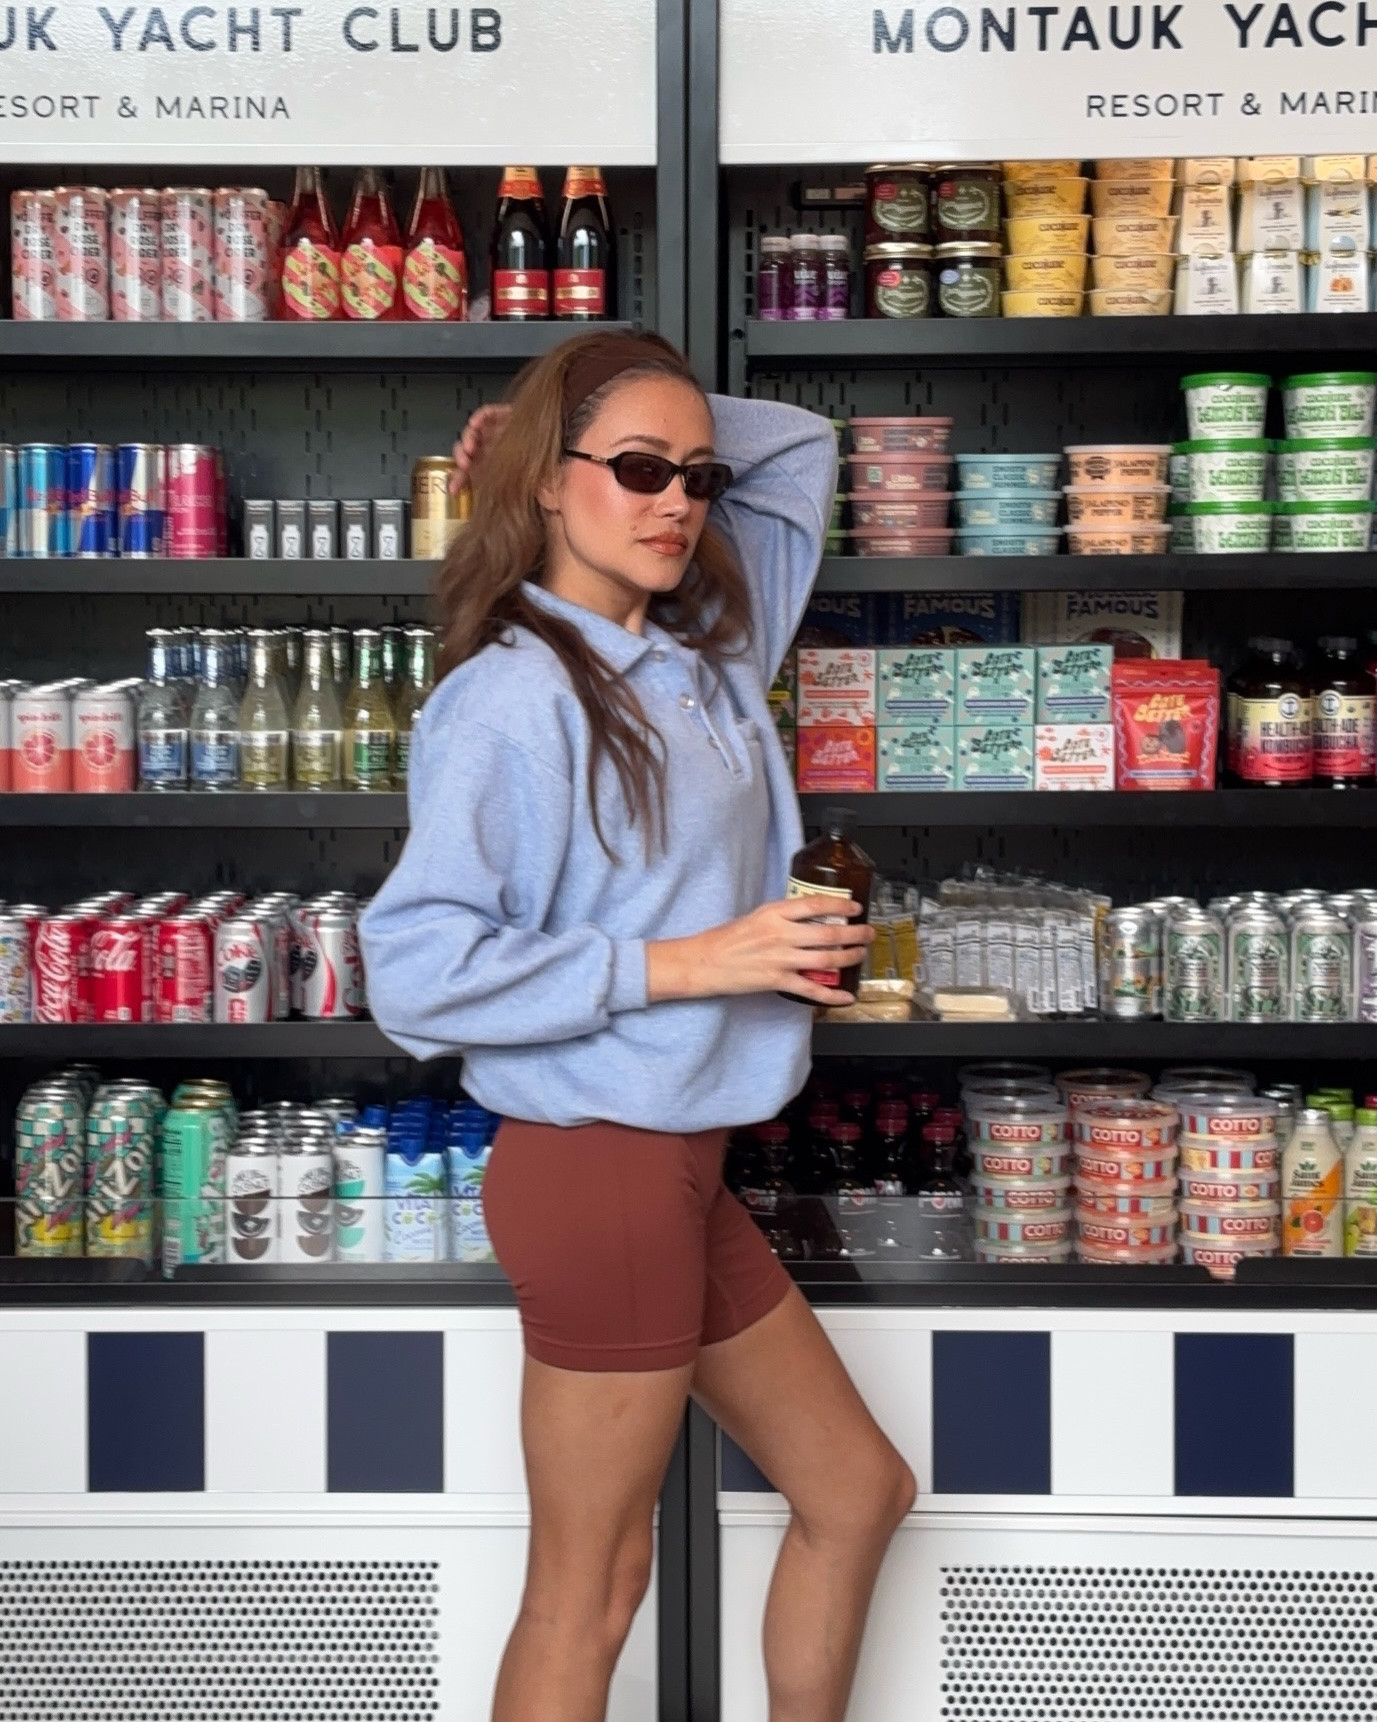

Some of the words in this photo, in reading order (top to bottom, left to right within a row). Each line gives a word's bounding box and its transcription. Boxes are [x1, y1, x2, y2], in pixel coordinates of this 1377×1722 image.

[97, 7, 303, 52] YACHT
[342, 7, 502, 52] CLUB
[873, 5, 1183, 54] MONTAUK
[1223, 1, 1377, 48] YACH
[118, 95, 138, 118] &
[156, 96, 290, 119] MARINA
[1087, 93, 1224, 118] RESORT
[1241, 93, 1261, 115] &
[1280, 91, 1377, 115] MARI
[904, 599, 996, 619] FAMOUS
[1067, 601, 1159, 619] FAMOUS
[991, 1124, 1041, 1138] COTTO
[1210, 1118, 1259, 1132] COTTO
[1091, 1128, 1140, 1143] COTTO
[983, 1157, 1031, 1171] COTTO
[1080, 1158, 1119, 1173] COTTO
[1007, 1191, 1055, 1204] COTTO
[1190, 1184, 1237, 1198] COTTO
[1084, 1225, 1127, 1240] COTTO
[1223, 1218, 1269, 1232] COTTO
